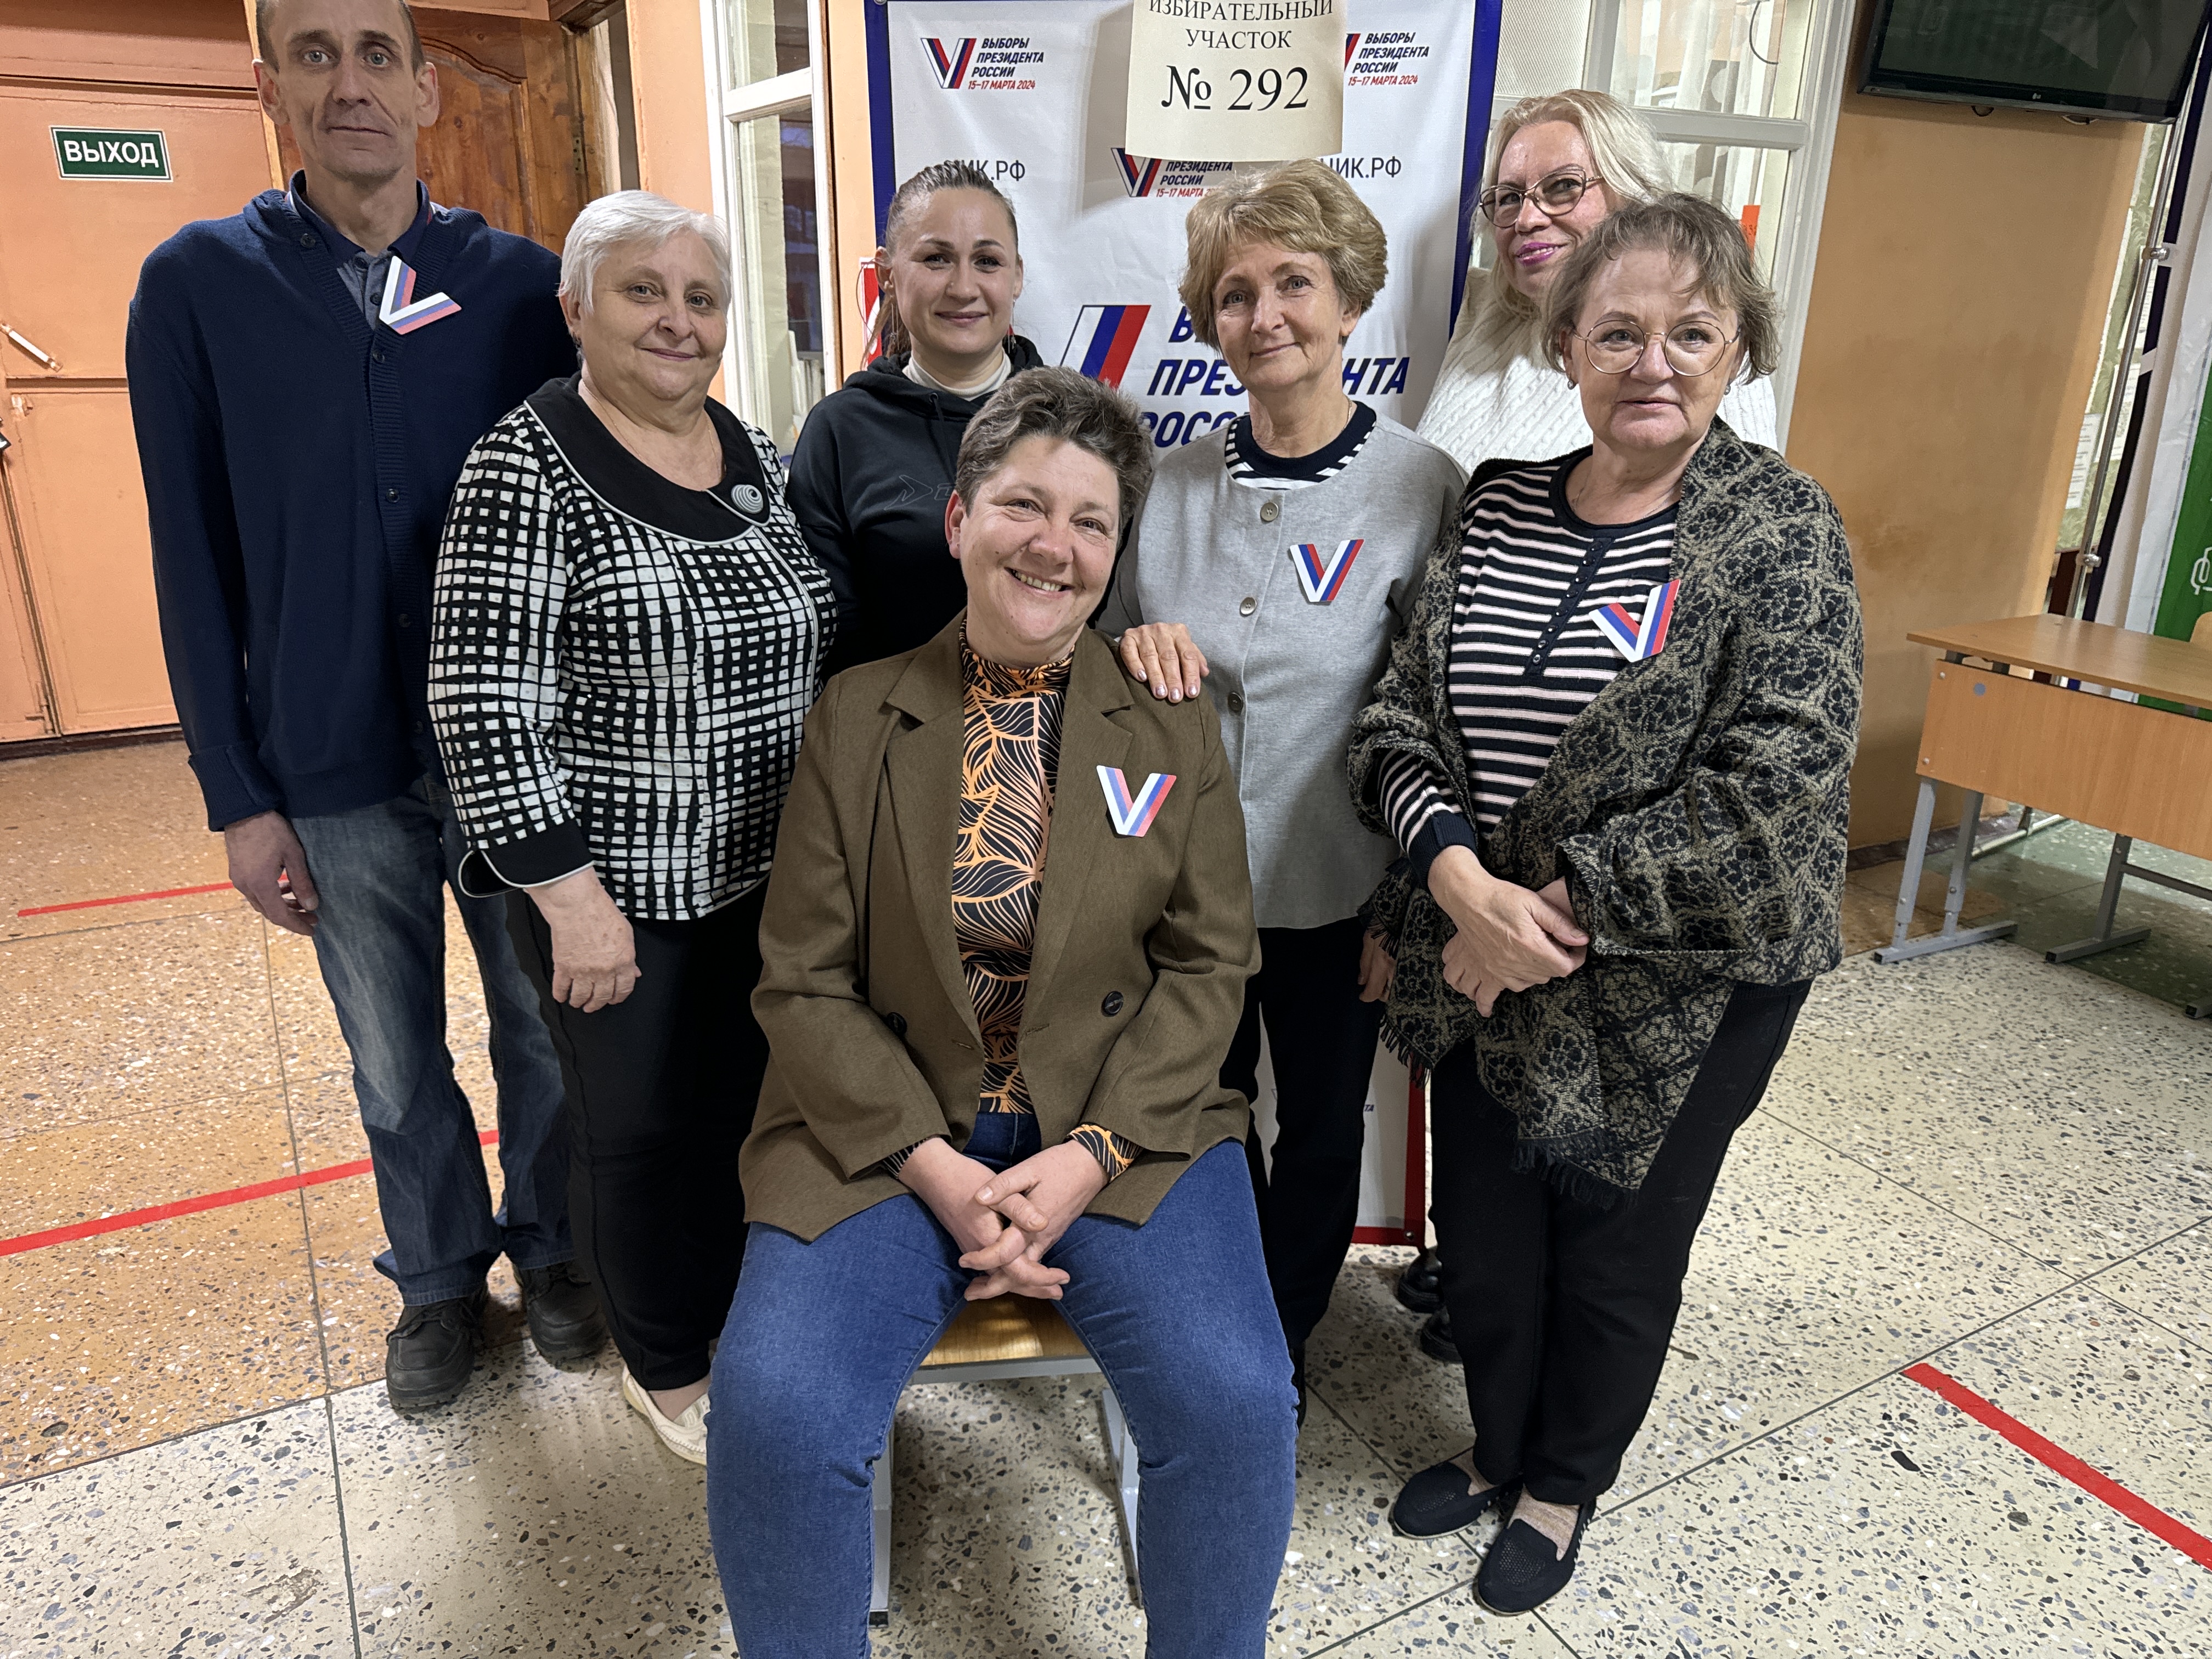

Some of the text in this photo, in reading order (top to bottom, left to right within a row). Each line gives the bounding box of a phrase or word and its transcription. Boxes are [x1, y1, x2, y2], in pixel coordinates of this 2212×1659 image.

[981, 37, 1030, 49] ВЫБОРЫ
[1185, 28, 1292, 49] УЧАСТОК
[1365, 32, 1416, 44] ВЫБОРЫ
[975, 52, 1045, 65] ПРЕЗИДЕНТА
[1358, 46, 1430, 60] ПРЕЗИДЕНТА
[971, 66, 1016, 77] РОССИИ
[1352, 61, 1398, 74] РОССИИ
[990, 80, 1015, 89] МАРТА
[1016, 80, 1036, 89] 2024
[1370, 75, 1398, 86] МАРТА
[1398, 75, 1418, 85] 2024
[1161, 65, 1309, 111] № 292
[63, 140, 159, 168] ВЫХОД
[1165, 161, 1233, 173] ПРЕЗИДЕНТА
[1159, 174, 1204, 185] РОССИИ
[1177, 188, 1204, 198] МАРТА
